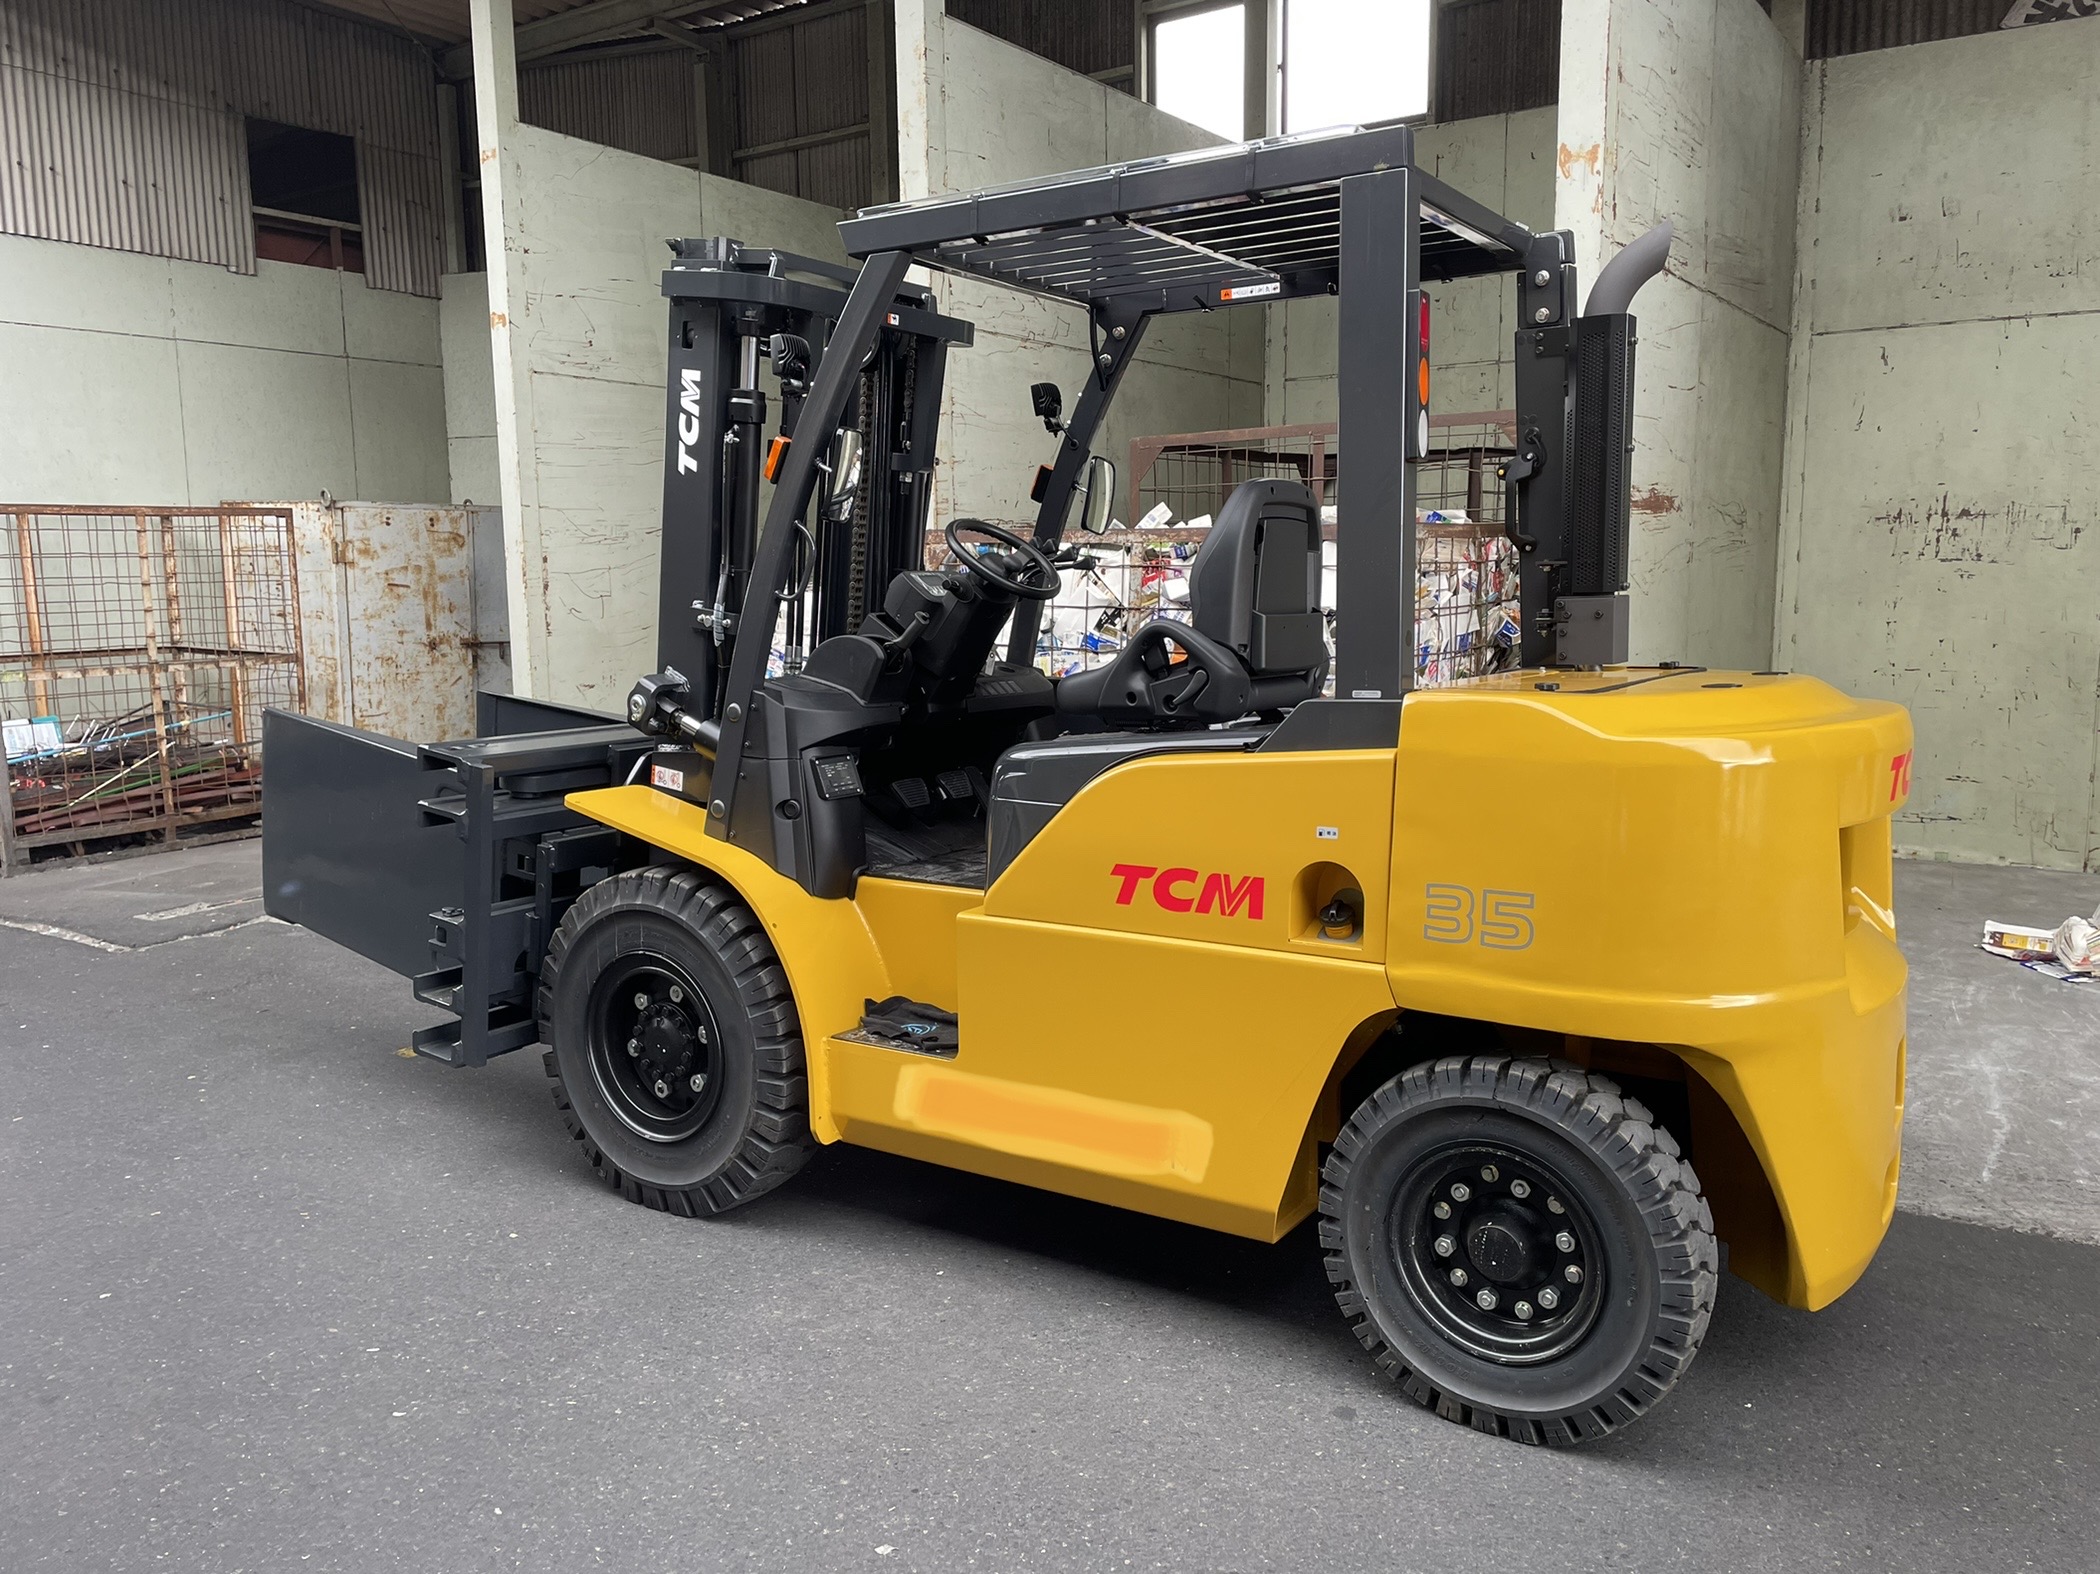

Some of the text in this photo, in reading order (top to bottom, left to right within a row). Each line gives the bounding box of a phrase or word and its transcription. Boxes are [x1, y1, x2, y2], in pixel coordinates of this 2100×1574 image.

[678, 368, 701, 476] TCM
[1110, 863, 1265, 921] TCM
[1423, 882, 1535, 951] 35
